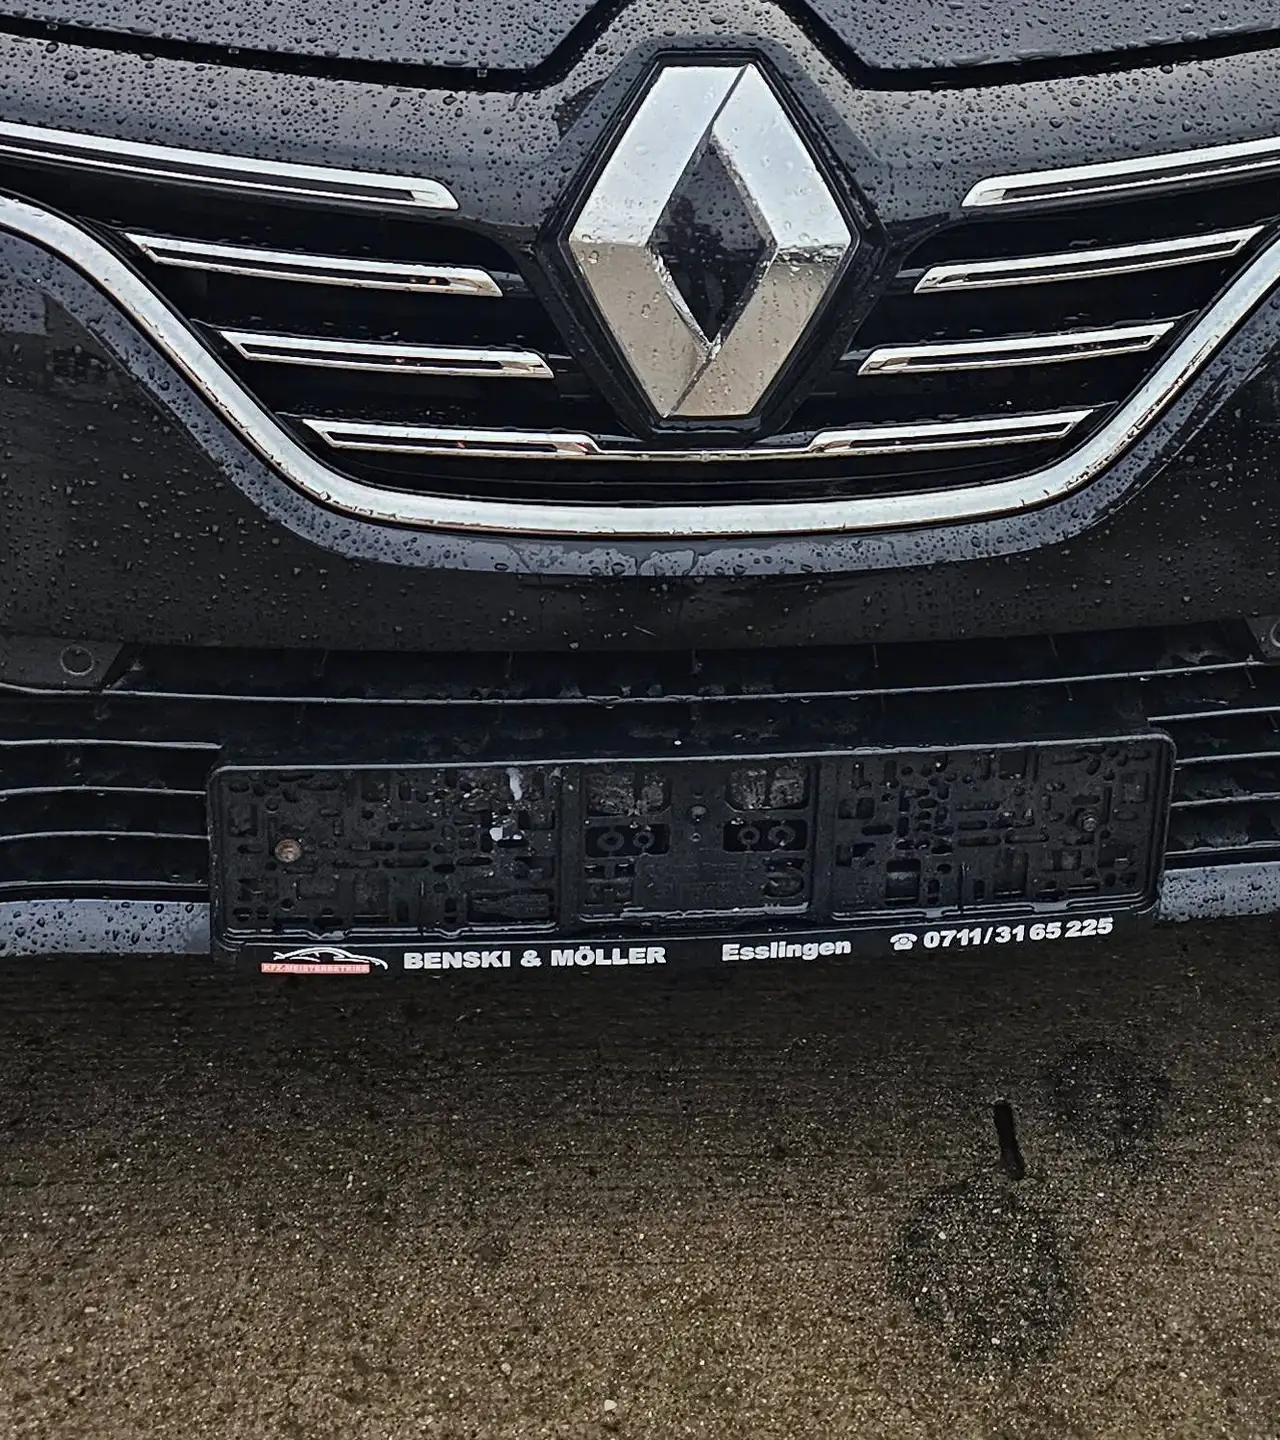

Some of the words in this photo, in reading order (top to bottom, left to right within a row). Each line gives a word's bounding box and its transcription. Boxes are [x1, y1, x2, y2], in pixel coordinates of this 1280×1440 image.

[403, 950, 511, 970] BENSKI
[520, 949, 543, 968] &
[550, 946, 667, 967] MÖLLER
[722, 940, 851, 962] Esslingen
